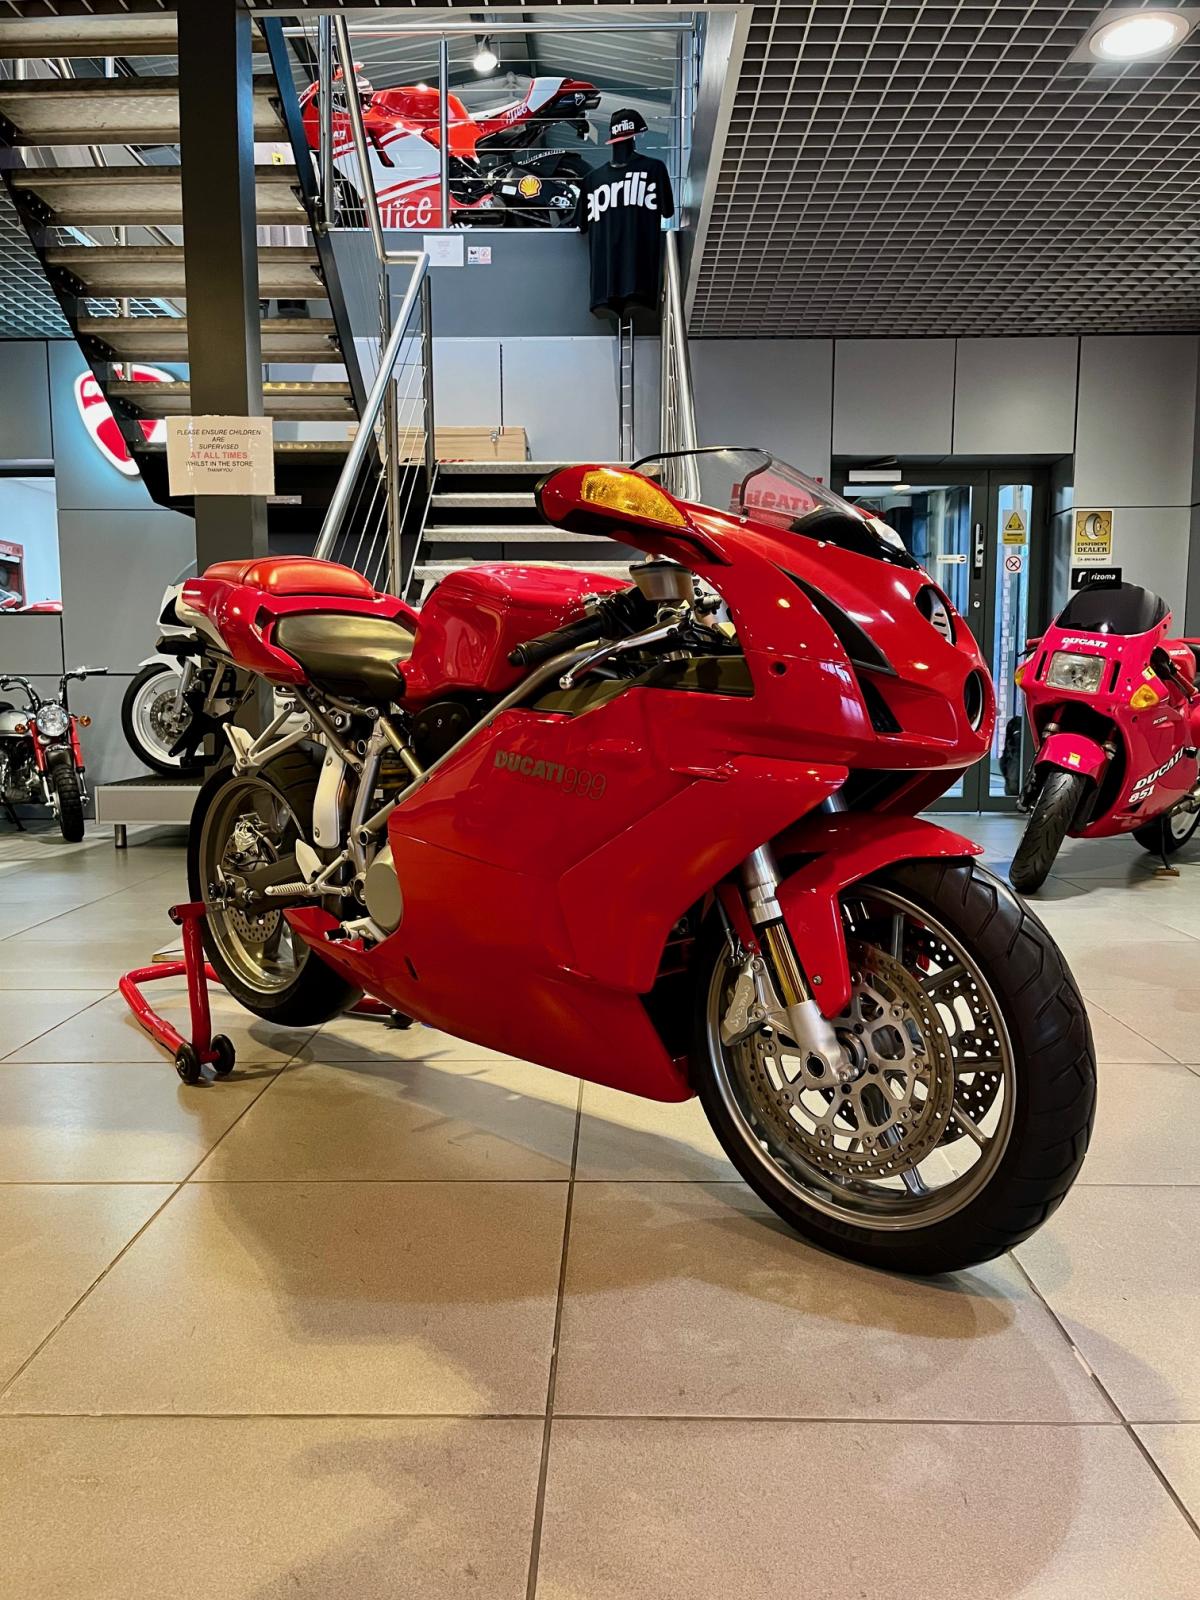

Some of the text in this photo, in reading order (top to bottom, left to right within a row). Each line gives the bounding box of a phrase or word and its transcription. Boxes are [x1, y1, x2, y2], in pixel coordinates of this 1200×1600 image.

[379, 196, 432, 228] lice
[190, 451, 248, 459] AT ALL TIMES
[1091, 573, 1116, 581] rizoma
[1061, 636, 1109, 649] DUCATI
[1132, 745, 1185, 791] DUCATI
[1128, 784, 1155, 803] 851
